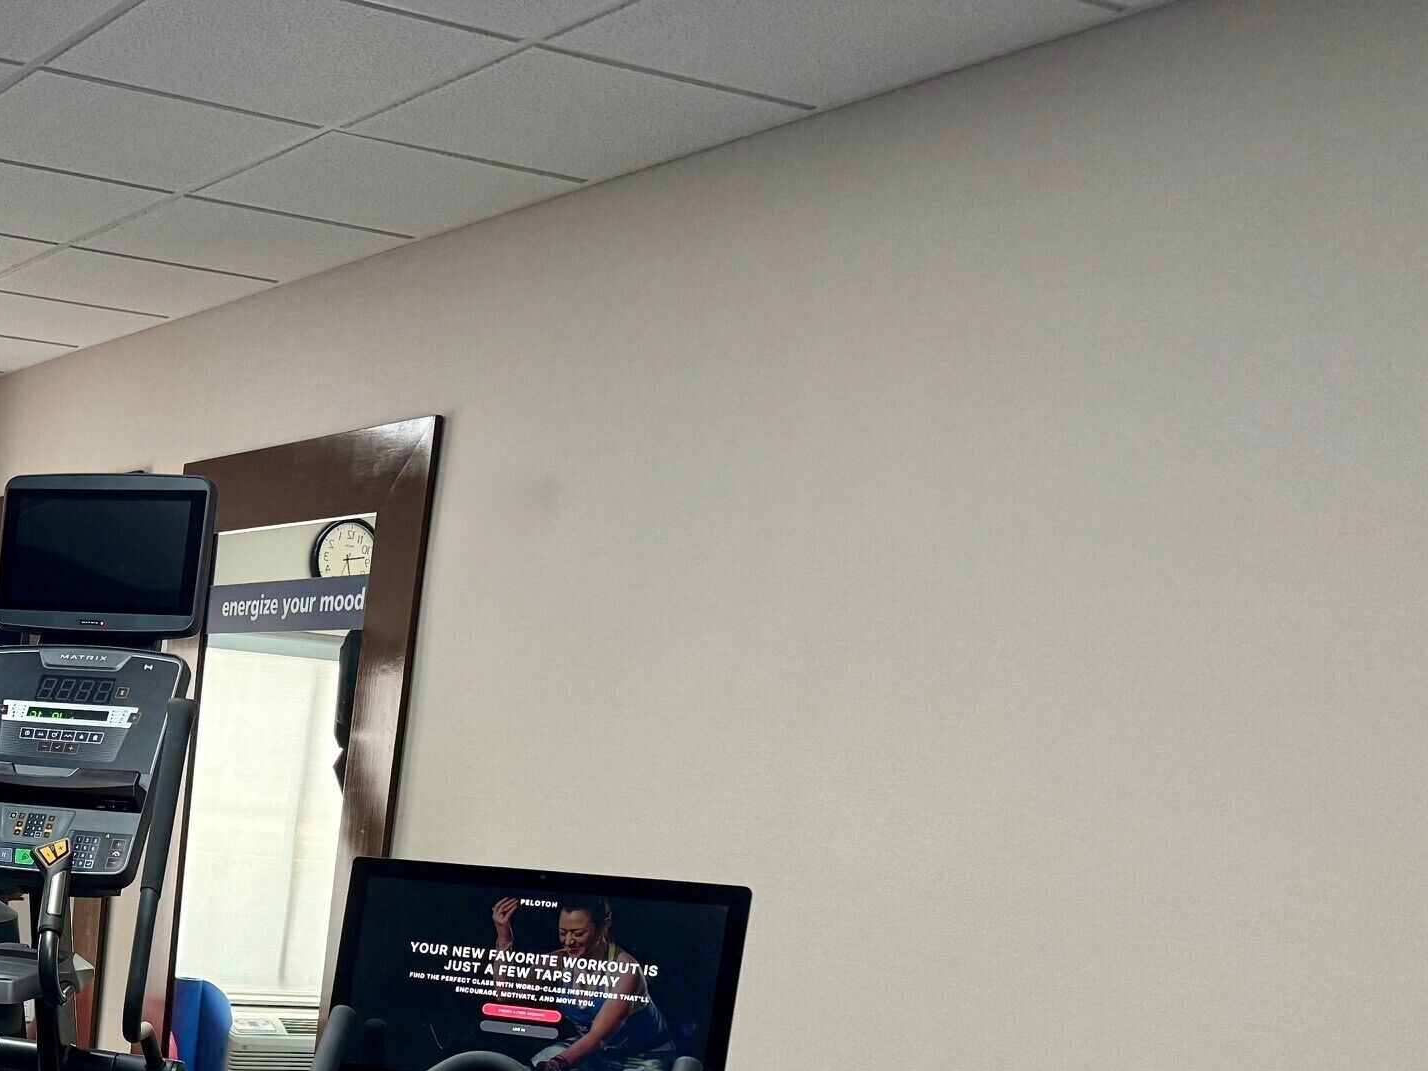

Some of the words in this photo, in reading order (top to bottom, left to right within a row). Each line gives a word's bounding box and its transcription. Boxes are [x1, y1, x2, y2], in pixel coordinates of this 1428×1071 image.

[222, 593, 278, 621] energize
[281, 595, 316, 619] your
[319, 587, 366, 612] mood
[520, 898, 558, 908] PELOTON
[410, 941, 448, 956] YOUR
[452, 945, 485, 959] NEW
[488, 949, 558, 967] FAVORITE
[563, 956, 640, 975] WORKOUT
[643, 964, 659, 977] IS
[443, 959, 481, 974] JUST
[484, 963, 494, 975] A
[498, 964, 531, 979] FEW
[534, 968, 572, 983] TAPS
[575, 972, 620, 988] AWAY
[409, 971, 425, 979] FIND
[426, 973, 440, 981] THE
[440, 975, 471, 984] PERFECT
[471, 978, 494, 986] CLASS
[567, 988, 618, 1000] INSTRUCTORS
[538, 995, 555, 1003] AND
[555, 997, 577, 1005] MOVE
[578, 999, 595, 1007] YOU.
